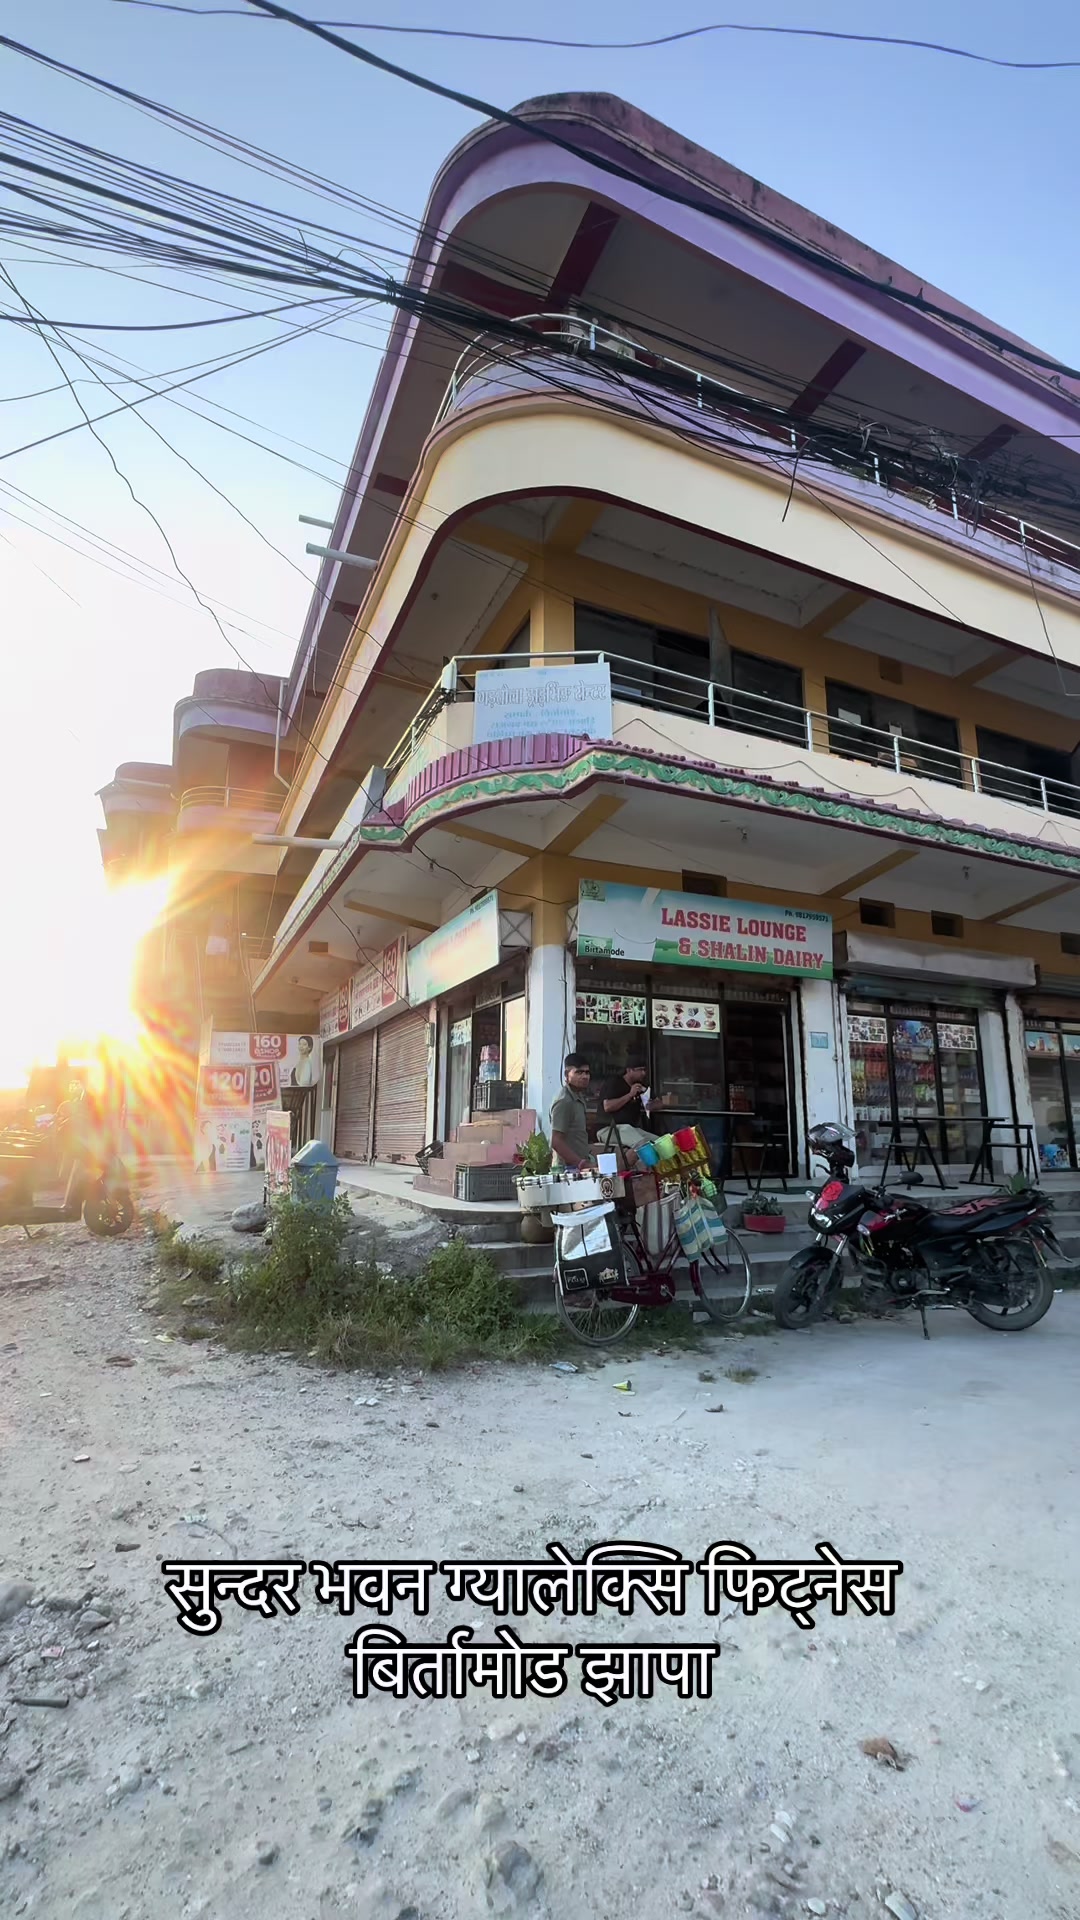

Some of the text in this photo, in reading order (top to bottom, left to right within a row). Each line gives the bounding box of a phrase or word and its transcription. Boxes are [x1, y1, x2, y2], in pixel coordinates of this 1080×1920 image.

[661, 907, 807, 942] LASSIE LOUNGE
[584, 945, 625, 956] Birtamode
[678, 937, 824, 970] & SHALIN DAIRY
[253, 1035, 281, 1048] 160
[211, 1071, 244, 1091] 120
